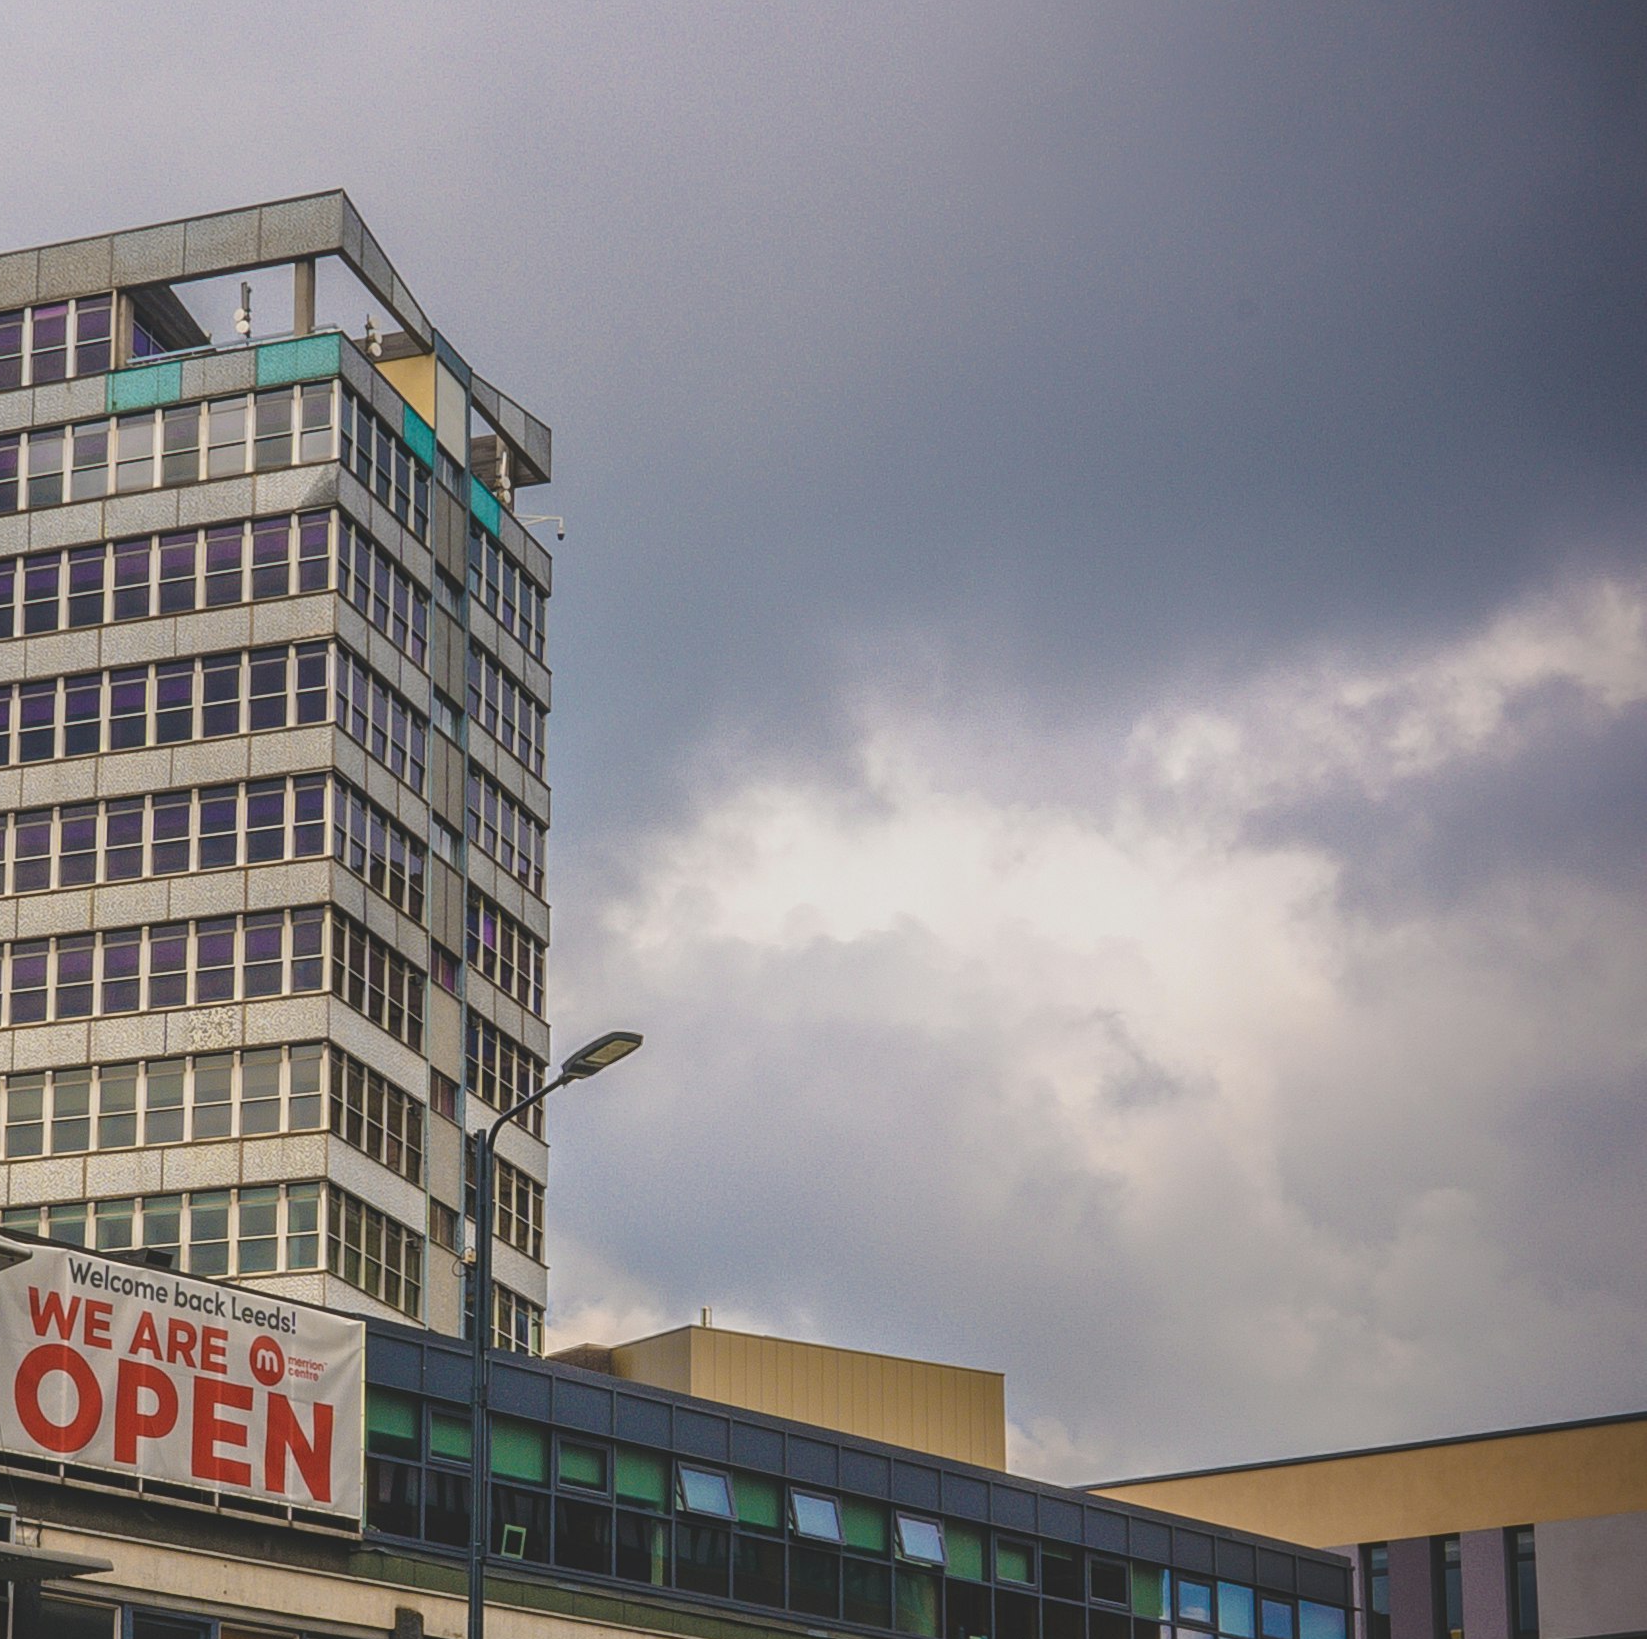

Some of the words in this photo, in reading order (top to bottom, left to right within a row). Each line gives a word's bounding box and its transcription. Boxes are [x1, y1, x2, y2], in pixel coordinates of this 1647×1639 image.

[28, 1286, 113, 1349] WE
[128, 1311, 229, 1375] ARE
[68, 1258, 168, 1305] Welcome
[174, 1283, 226, 1318] back
[232, 1297, 297, 1335] Leeds!
[288, 1356, 325, 1372] merrion
[288, 1367, 319, 1382] centre
[14, 1343, 333, 1504] OPEN
